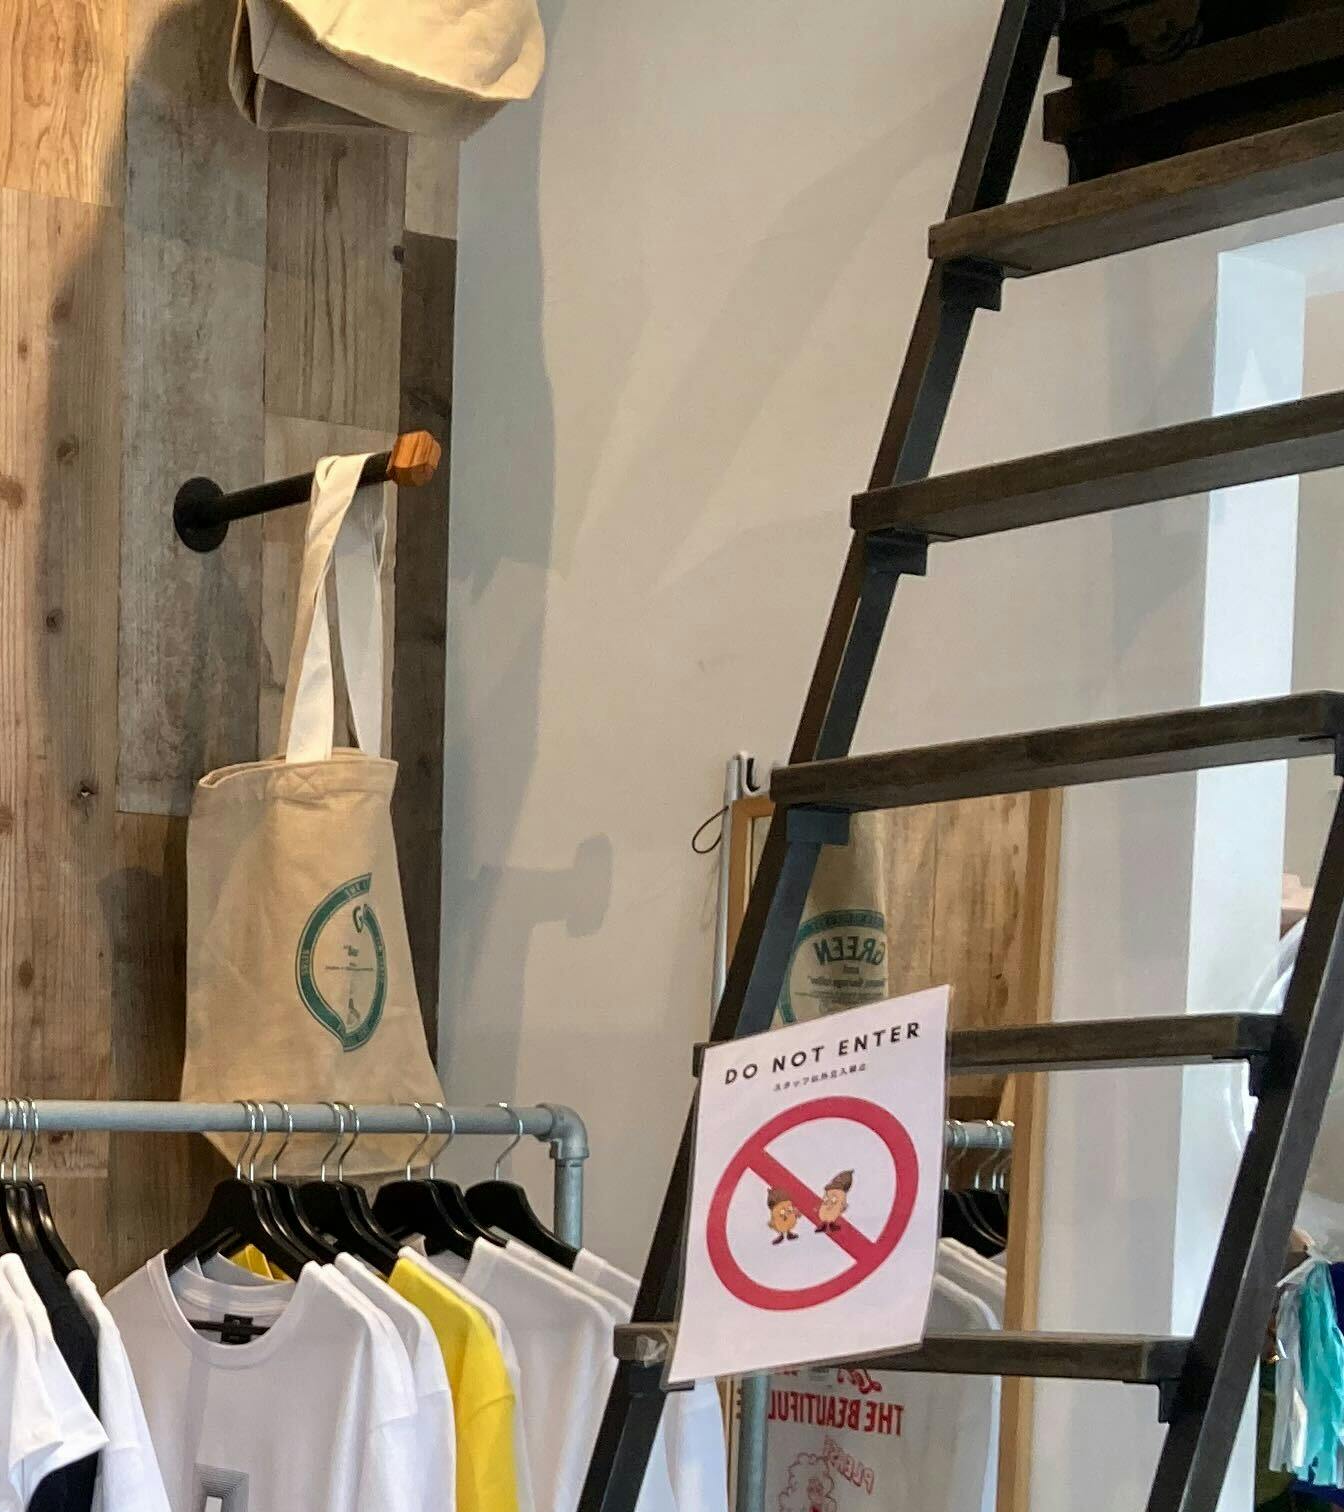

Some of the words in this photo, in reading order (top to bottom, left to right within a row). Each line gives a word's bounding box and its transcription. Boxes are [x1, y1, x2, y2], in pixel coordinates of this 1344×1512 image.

[725, 1063, 758, 1085] DO
[772, 1045, 825, 1073] NOT
[838, 1022, 920, 1056] ENTER
